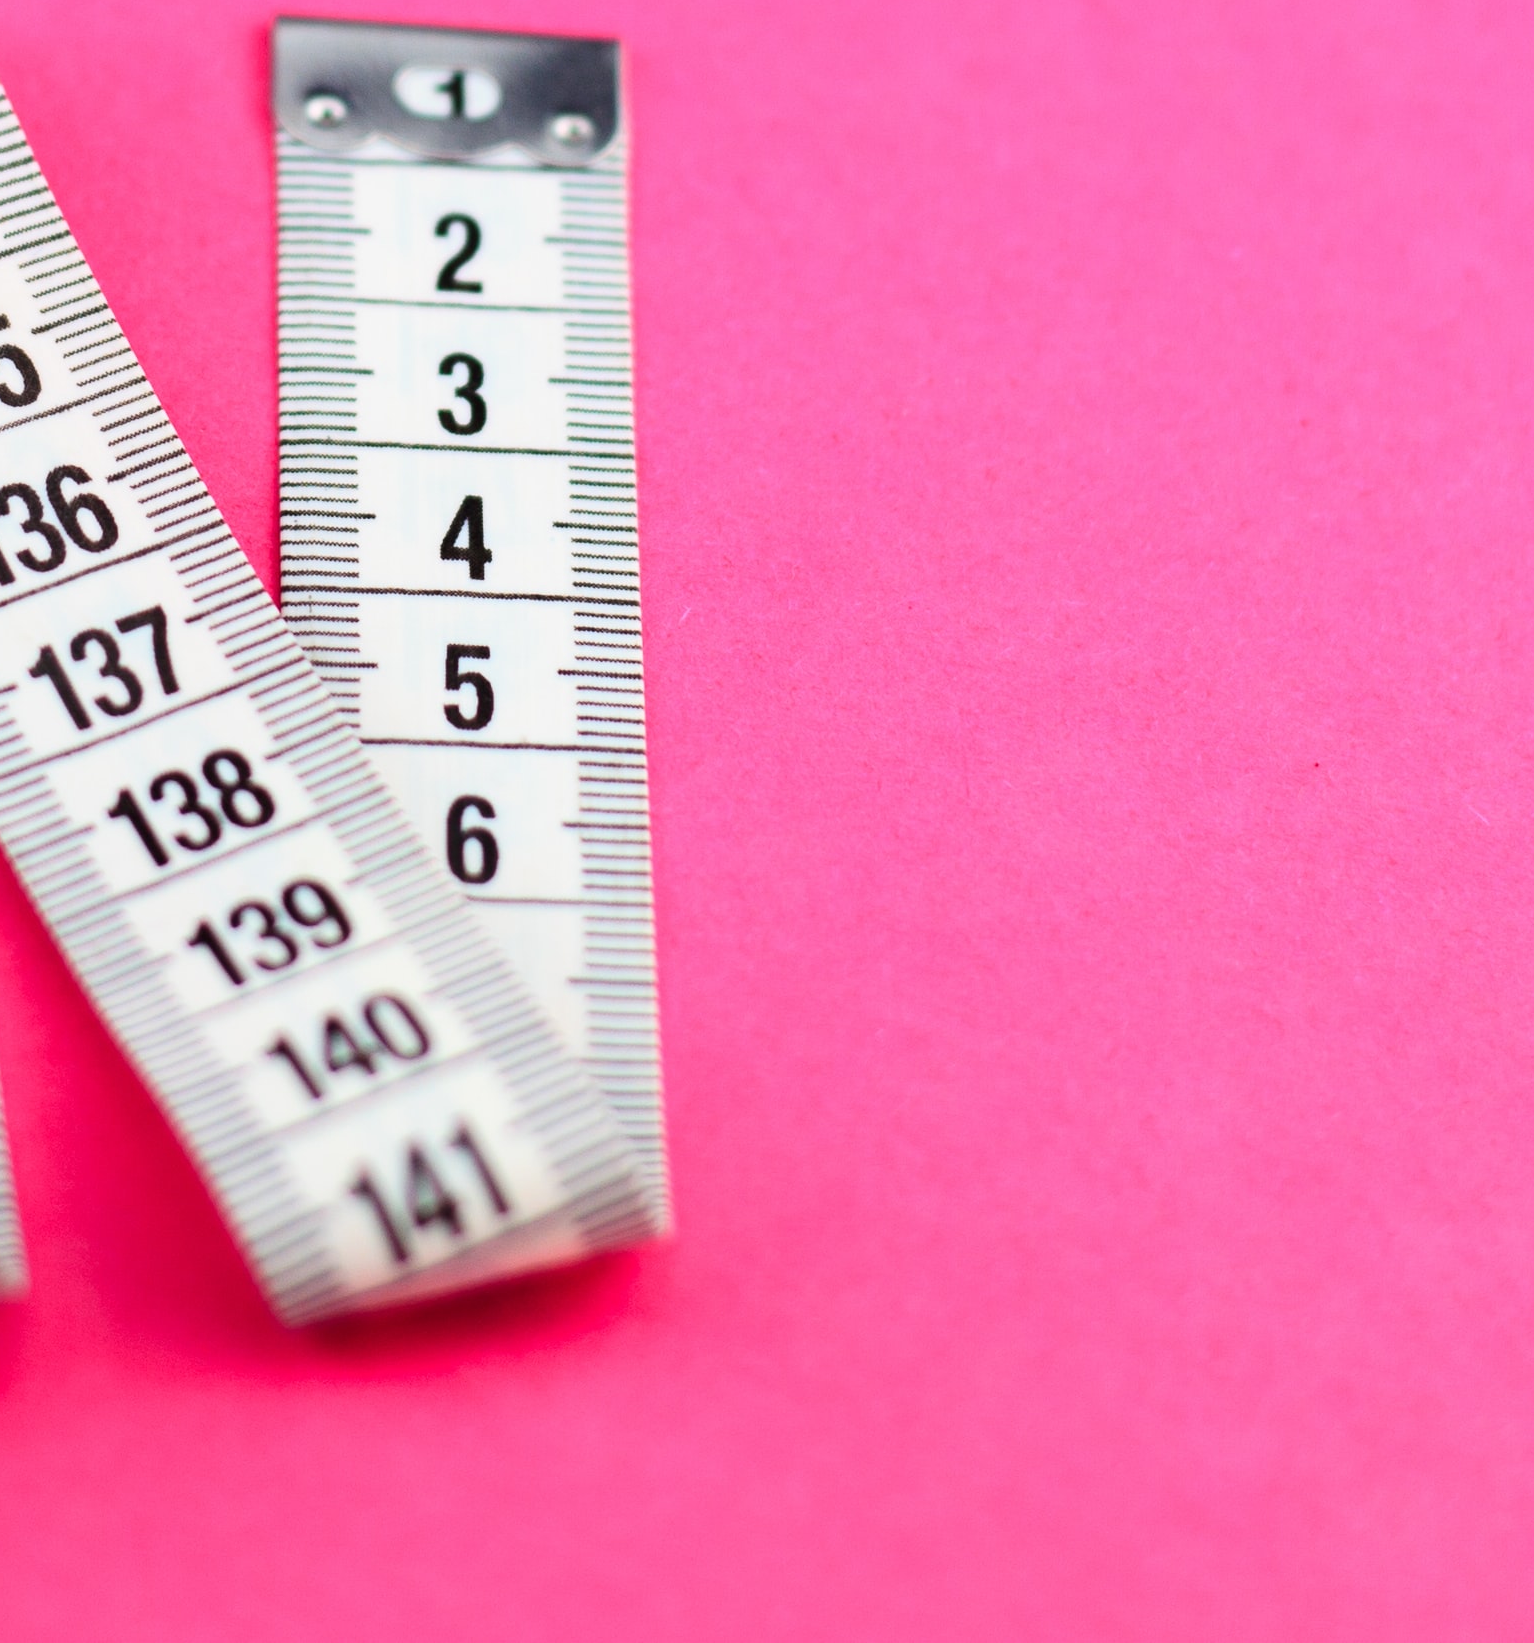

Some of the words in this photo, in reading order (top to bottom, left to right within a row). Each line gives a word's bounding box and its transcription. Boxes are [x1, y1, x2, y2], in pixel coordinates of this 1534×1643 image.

[434, 70, 465, 119] 1
[433, 213, 484, 293] 2
[437, 353, 488, 435] 3
[440, 495, 493, 580] 4
[28, 605, 181, 731] 137
[443, 644, 495, 731] 5
[107, 748, 277, 868] 138
[446, 795, 499, 884] 6
[187, 876, 353, 986] 139
[266, 991, 433, 1099] 140
[349, 1120, 511, 1263] 141
